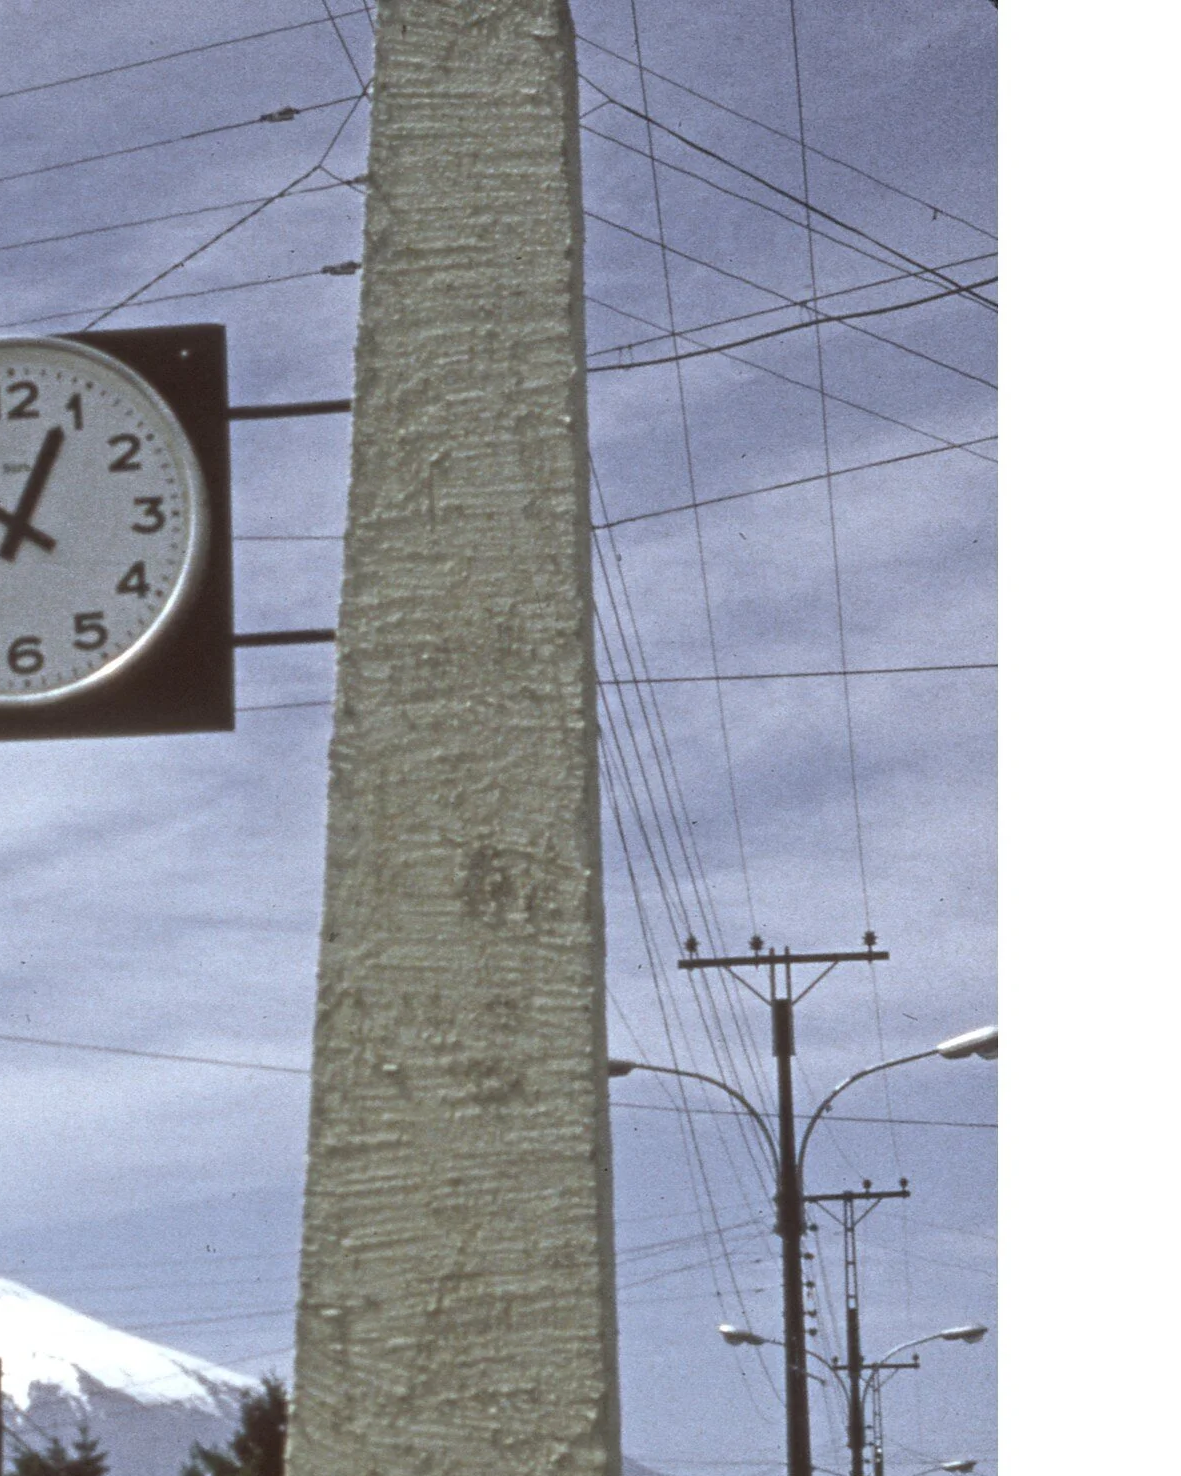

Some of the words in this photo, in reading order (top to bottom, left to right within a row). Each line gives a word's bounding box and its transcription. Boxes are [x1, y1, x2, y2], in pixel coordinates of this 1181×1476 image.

[66, 392, 84, 431] 1
[107, 433, 142, 473] 2
[131, 495, 166, 535] 3
[116, 560, 151, 599] 4
[73, 611, 108, 652] 5
[7, 636, 44, 675] 6
